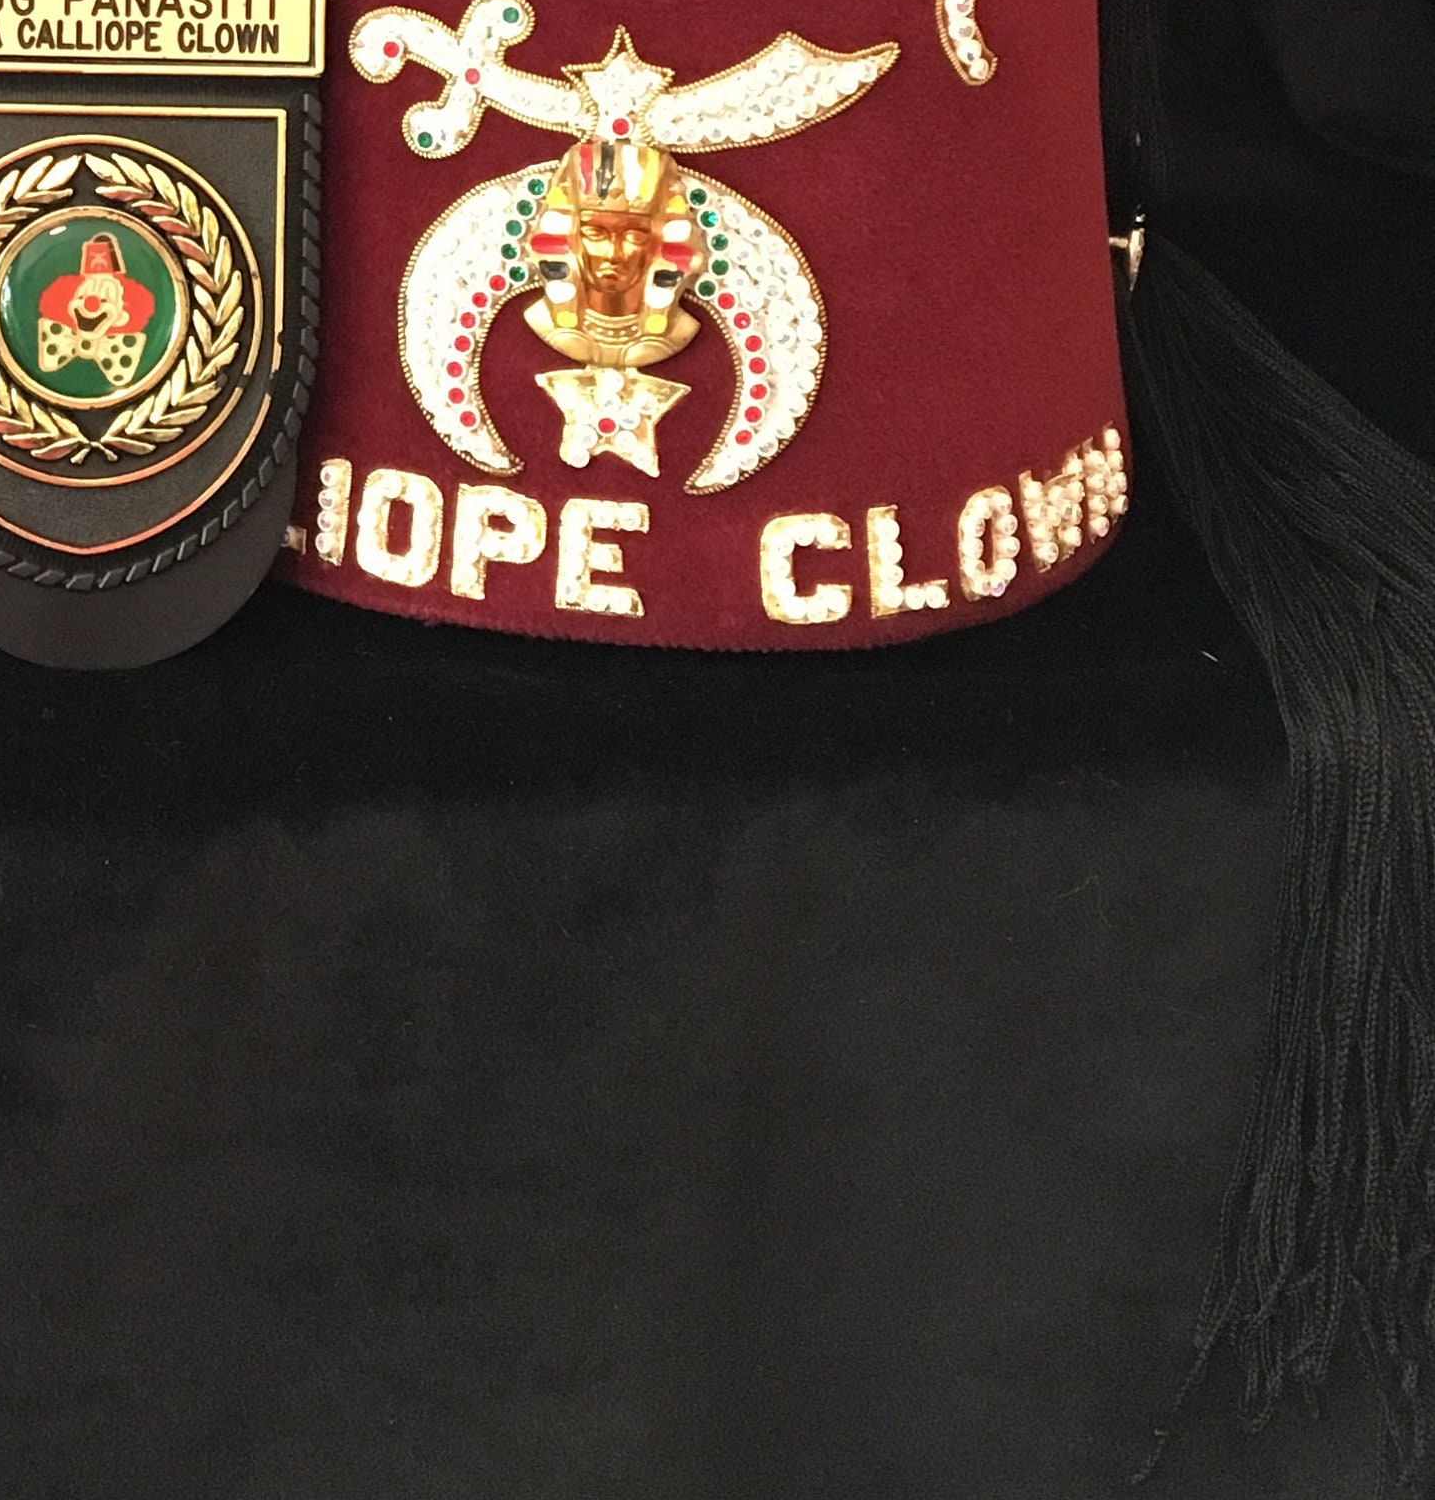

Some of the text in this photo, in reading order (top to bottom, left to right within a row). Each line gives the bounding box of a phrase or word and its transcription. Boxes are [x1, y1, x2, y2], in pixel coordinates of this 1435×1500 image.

[18, 18, 164, 52] CALLIOPE
[177, 22, 280, 54] CLOWN
[282, 422, 1129, 625] IOPE CLOWN
